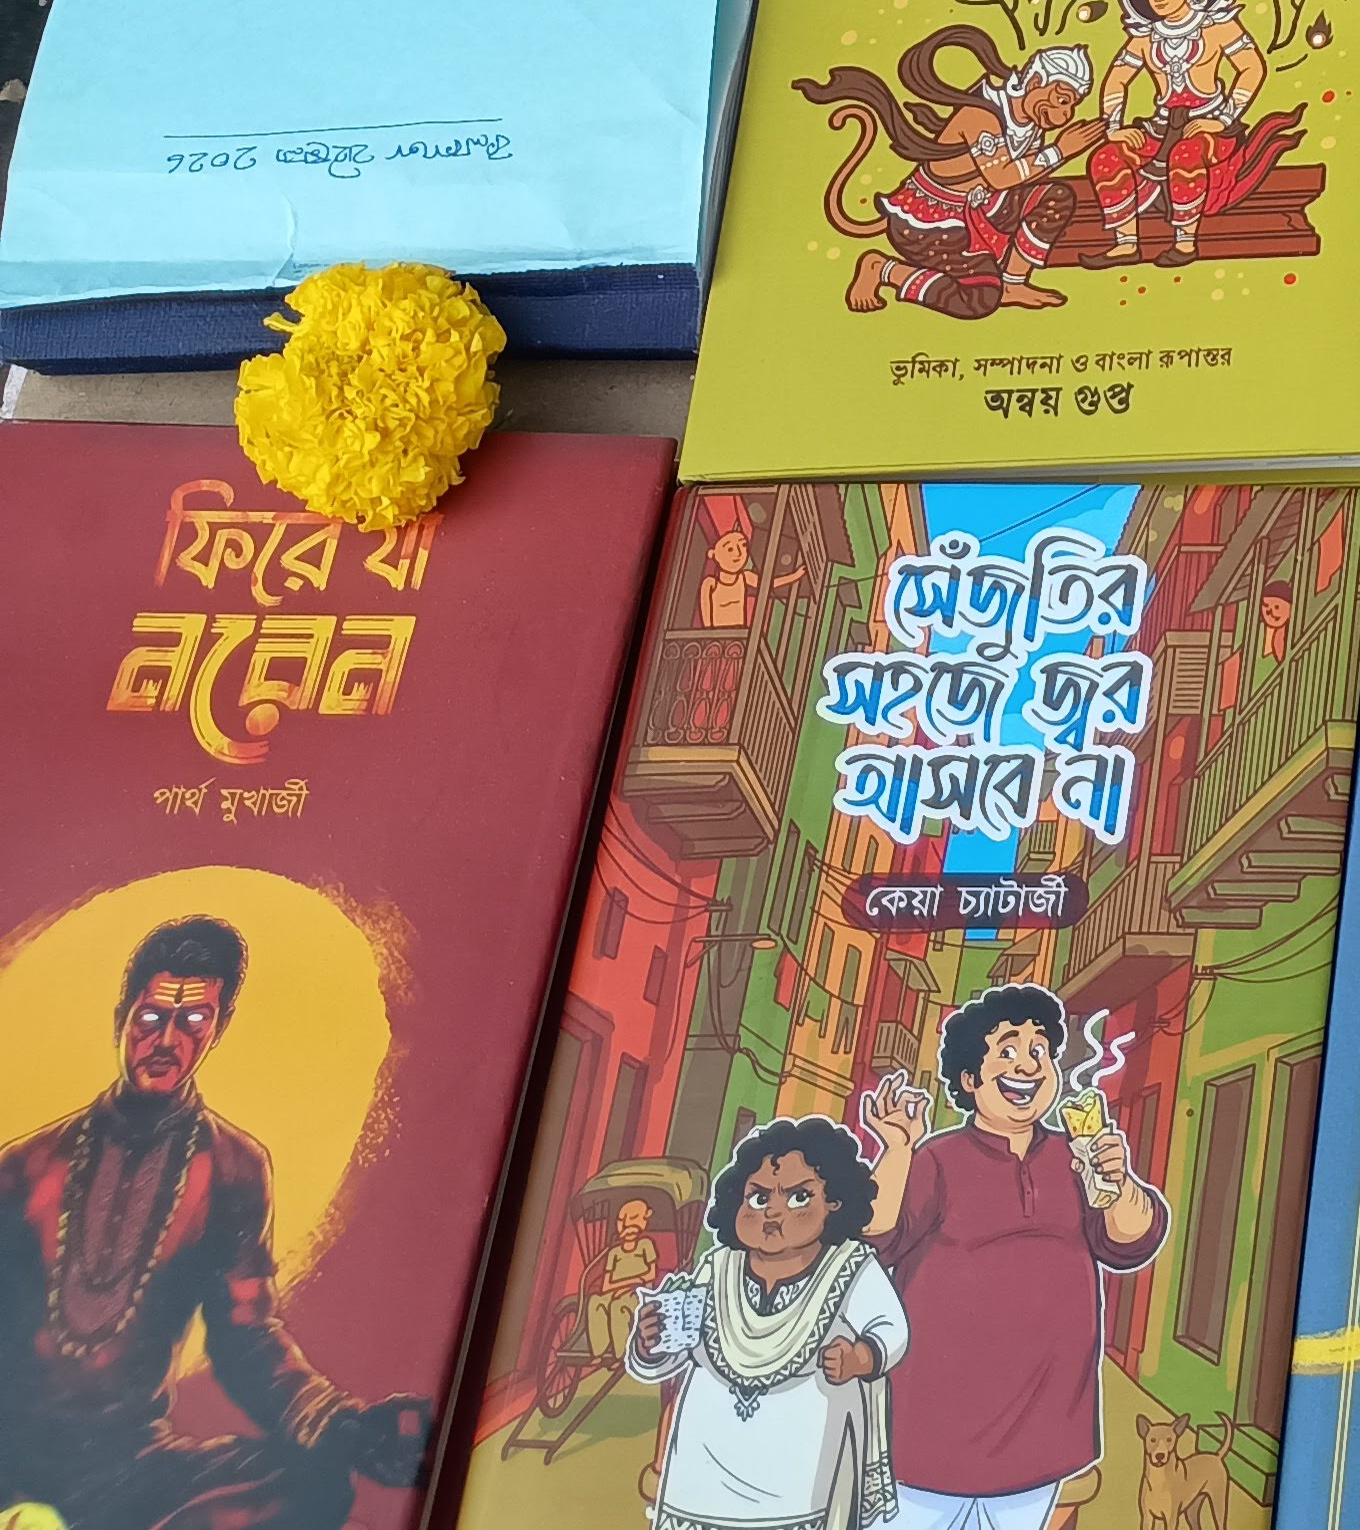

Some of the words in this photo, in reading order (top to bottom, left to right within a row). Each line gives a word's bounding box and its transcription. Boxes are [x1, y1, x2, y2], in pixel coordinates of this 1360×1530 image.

[167, 146, 258, 174] 2026
[890, 352, 964, 387] ভূমিকা,
[973, 353, 1063, 377] সম্পাদনা
[1071, 354, 1088, 373] ও
[1096, 349, 1153, 373] বাংলা
[1159, 346, 1232, 369] রূপান্তর
[984, 385, 1063, 419] অন্বয়
[1075, 381, 1134, 416] গুপ্ত
[155, 479, 344, 607] ফিরে
[893, 535, 1140, 659] সেঁজুতির
[106, 613, 417, 765] নরেন
[826, 660, 1010, 744] সহজে
[1031, 660, 1144, 752] জ্বর
[154, 776, 217, 816] পার্থ
[220, 778, 310, 826] মুখার্জী
[843, 753, 1036, 835] আসবে
[1062, 753, 1127, 836] না
[865, 884, 943, 918] কেয়া
[957, 874, 1069, 919] চ্যাটার্জী
